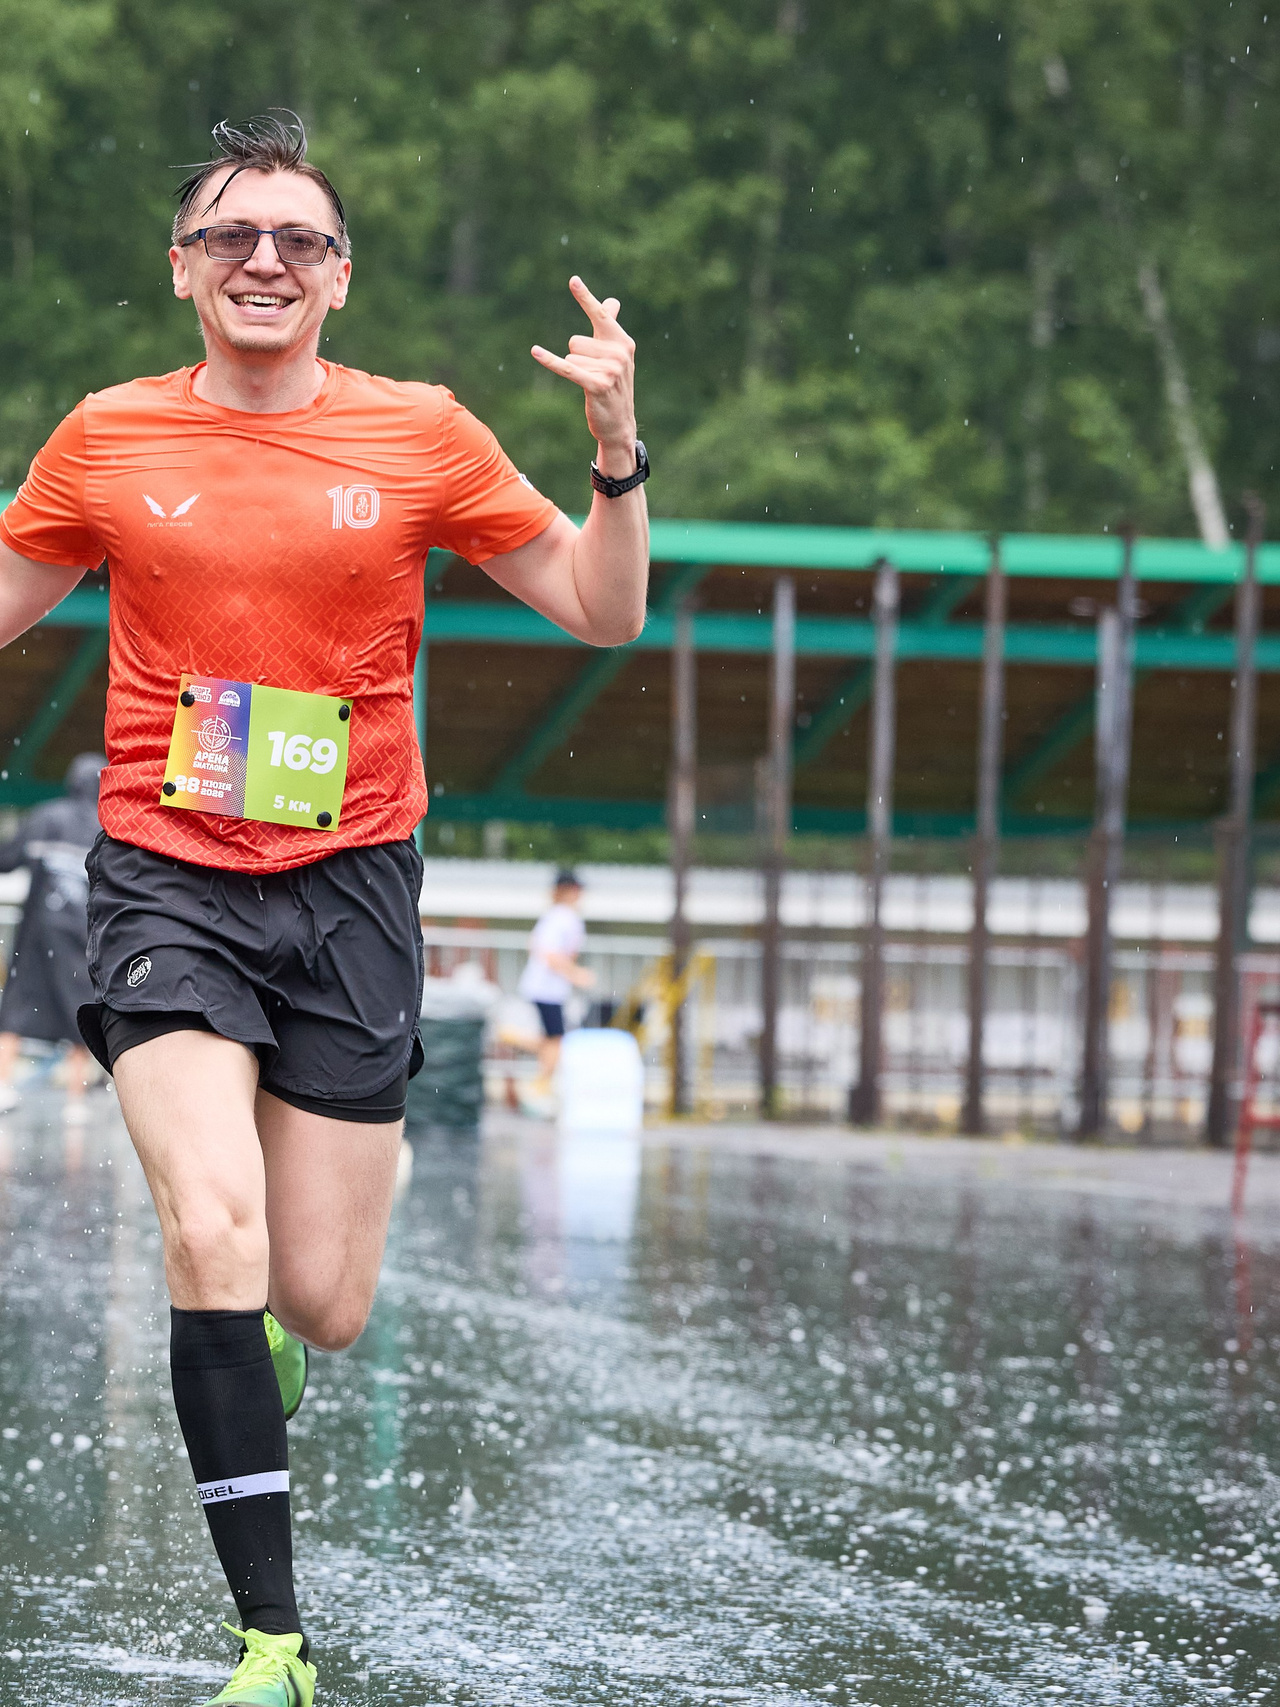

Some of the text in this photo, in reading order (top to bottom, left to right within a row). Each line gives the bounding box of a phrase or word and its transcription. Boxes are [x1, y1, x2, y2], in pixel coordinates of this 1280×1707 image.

[325, 484, 380, 530] 10
[194, 751, 229, 766] АРЕНА
[267, 730, 338, 775] 169
[193, 761, 228, 773] БИАТЛОНА
[175, 775, 232, 793] 28 ИЮНЯ
[272, 794, 285, 810] 5
